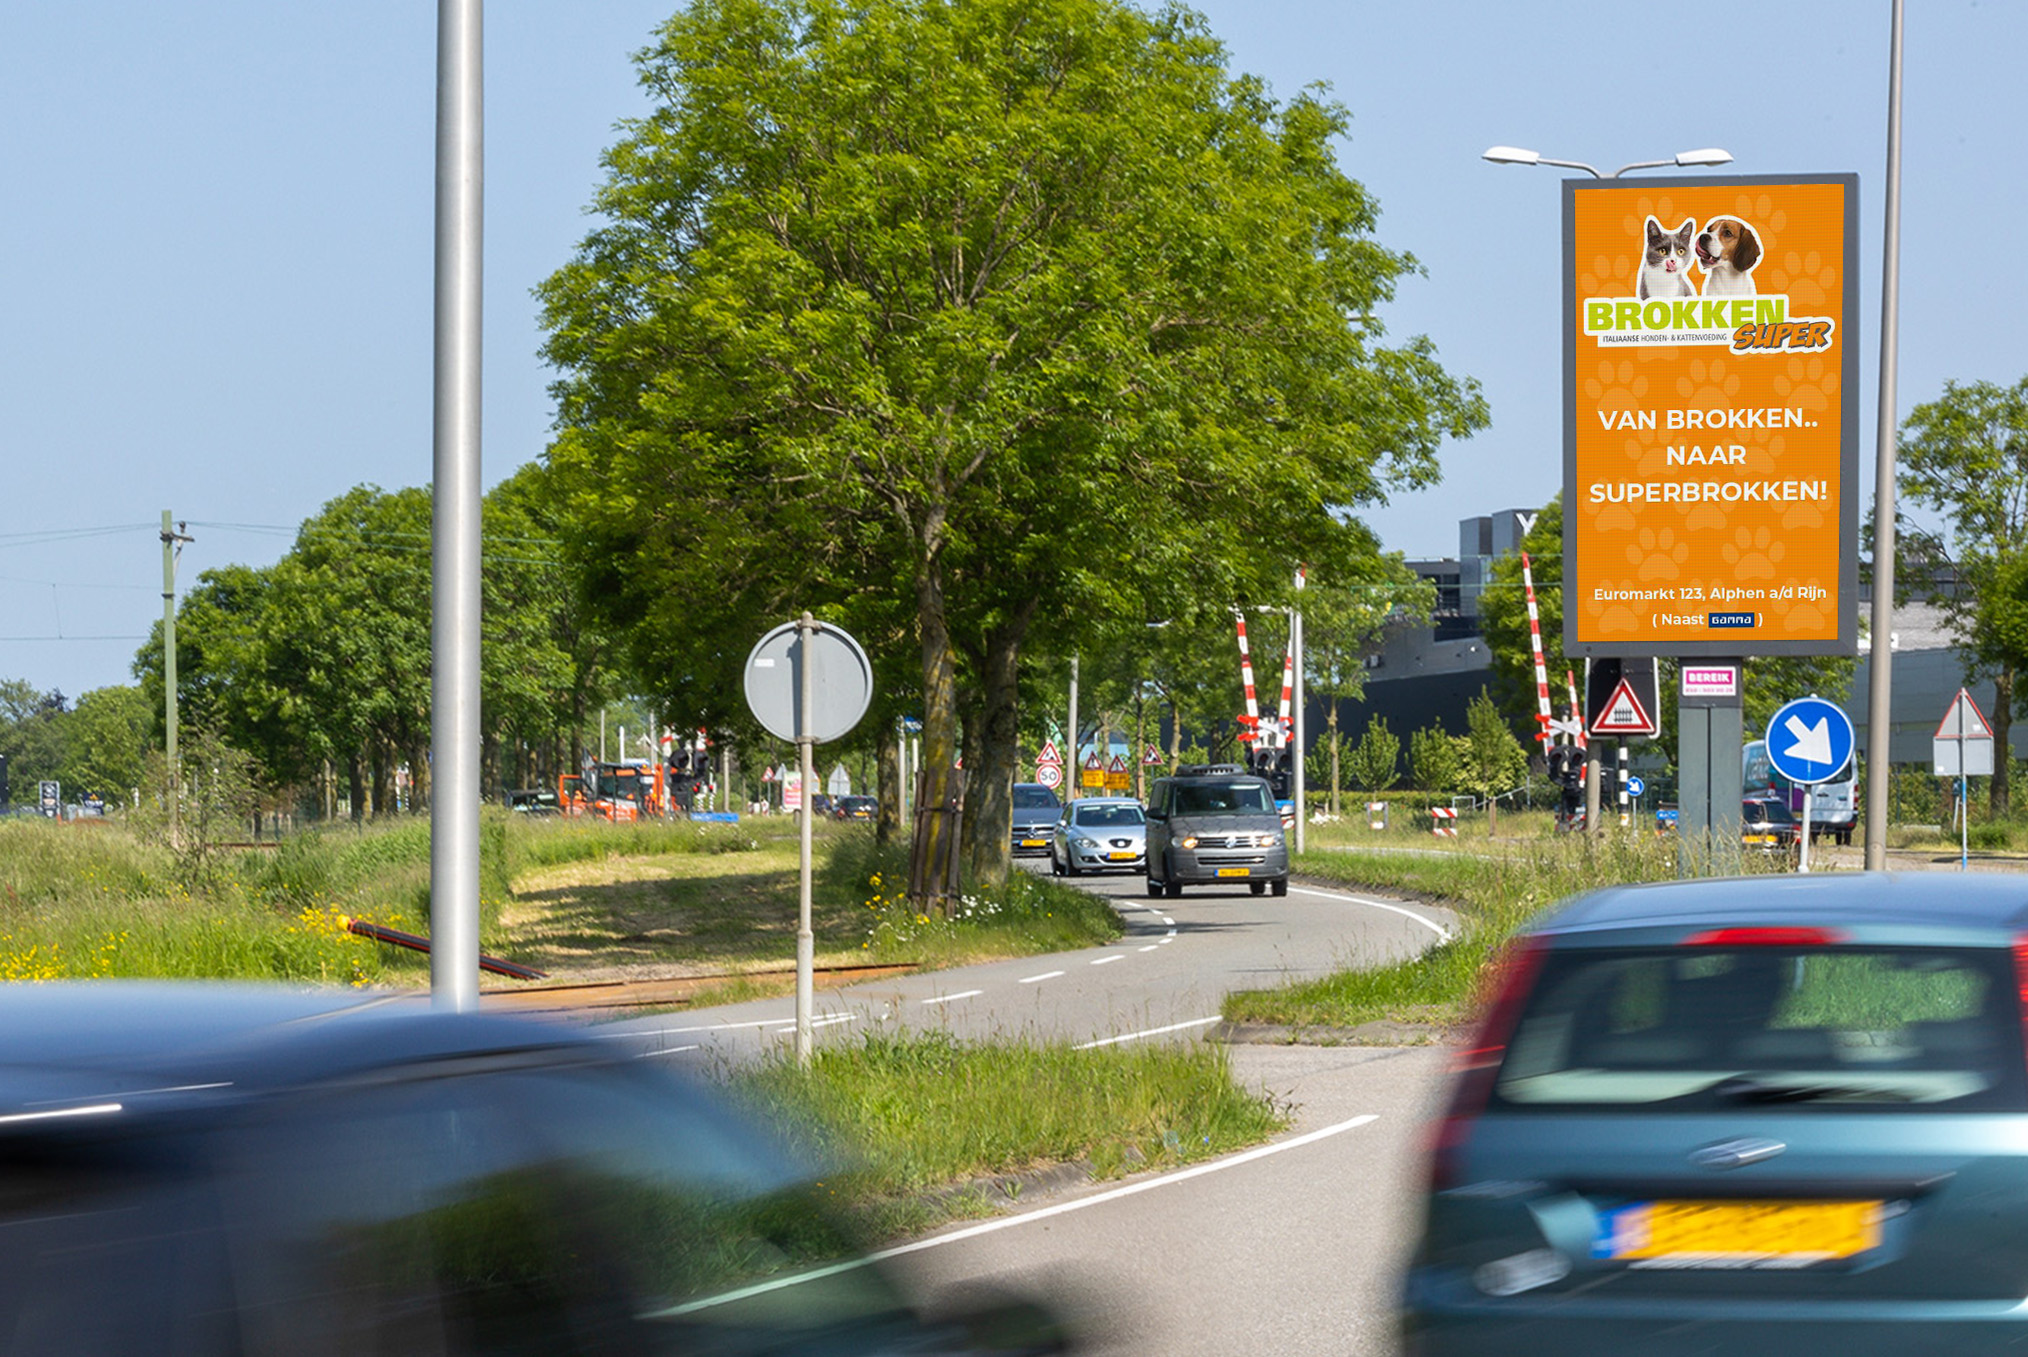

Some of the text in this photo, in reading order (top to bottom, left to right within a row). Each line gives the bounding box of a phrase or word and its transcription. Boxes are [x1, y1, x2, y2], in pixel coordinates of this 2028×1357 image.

[1588, 299, 1785, 331] BROKKEN
[1602, 335, 1640, 343] ITALIAANSE
[1677, 333, 1727, 341] KATTENVOEDING
[1732, 321, 1832, 350] SUPER
[1597, 407, 1818, 431] VAN BROKKEN..
[1666, 445, 1747, 466] NAAR
[1589, 480, 1828, 503] SUPERBROKKEN!
[1594, 586, 1827, 601] Euromarkt 123, Alphen a/d Rijn
[1661, 614, 1705, 625] Naast
[1688, 672, 1730, 683] BEREIK
[1041, 771, 1057, 781] 50
